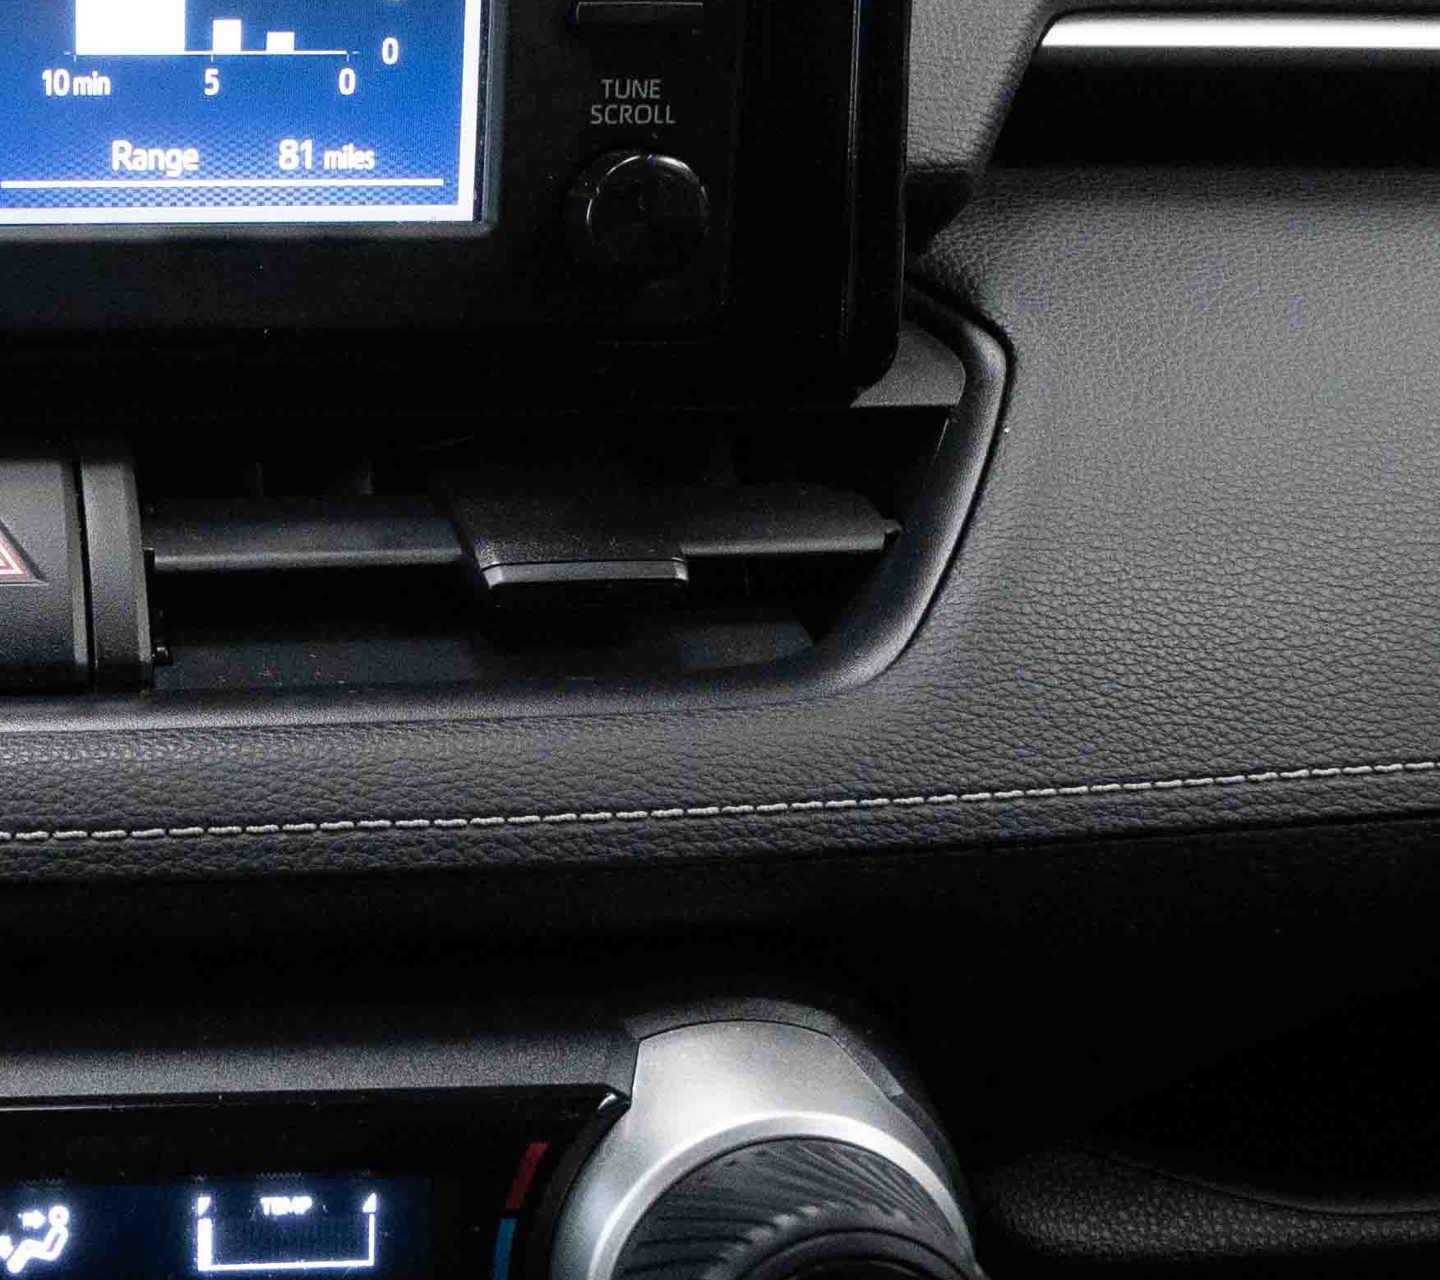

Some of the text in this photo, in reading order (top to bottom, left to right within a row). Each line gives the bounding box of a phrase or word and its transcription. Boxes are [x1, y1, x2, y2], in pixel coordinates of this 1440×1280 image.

[382, 38, 400, 65] 0
[41, 68, 111, 97] 10 min
[203, 68, 220, 96] 5
[338, 68, 356, 96] 0
[601, 78, 662, 100] TUNE
[590, 103, 676, 126] SCROLL
[111, 140, 376, 178] Range 81 miles
[260, 1195, 314, 1217] TEMP
